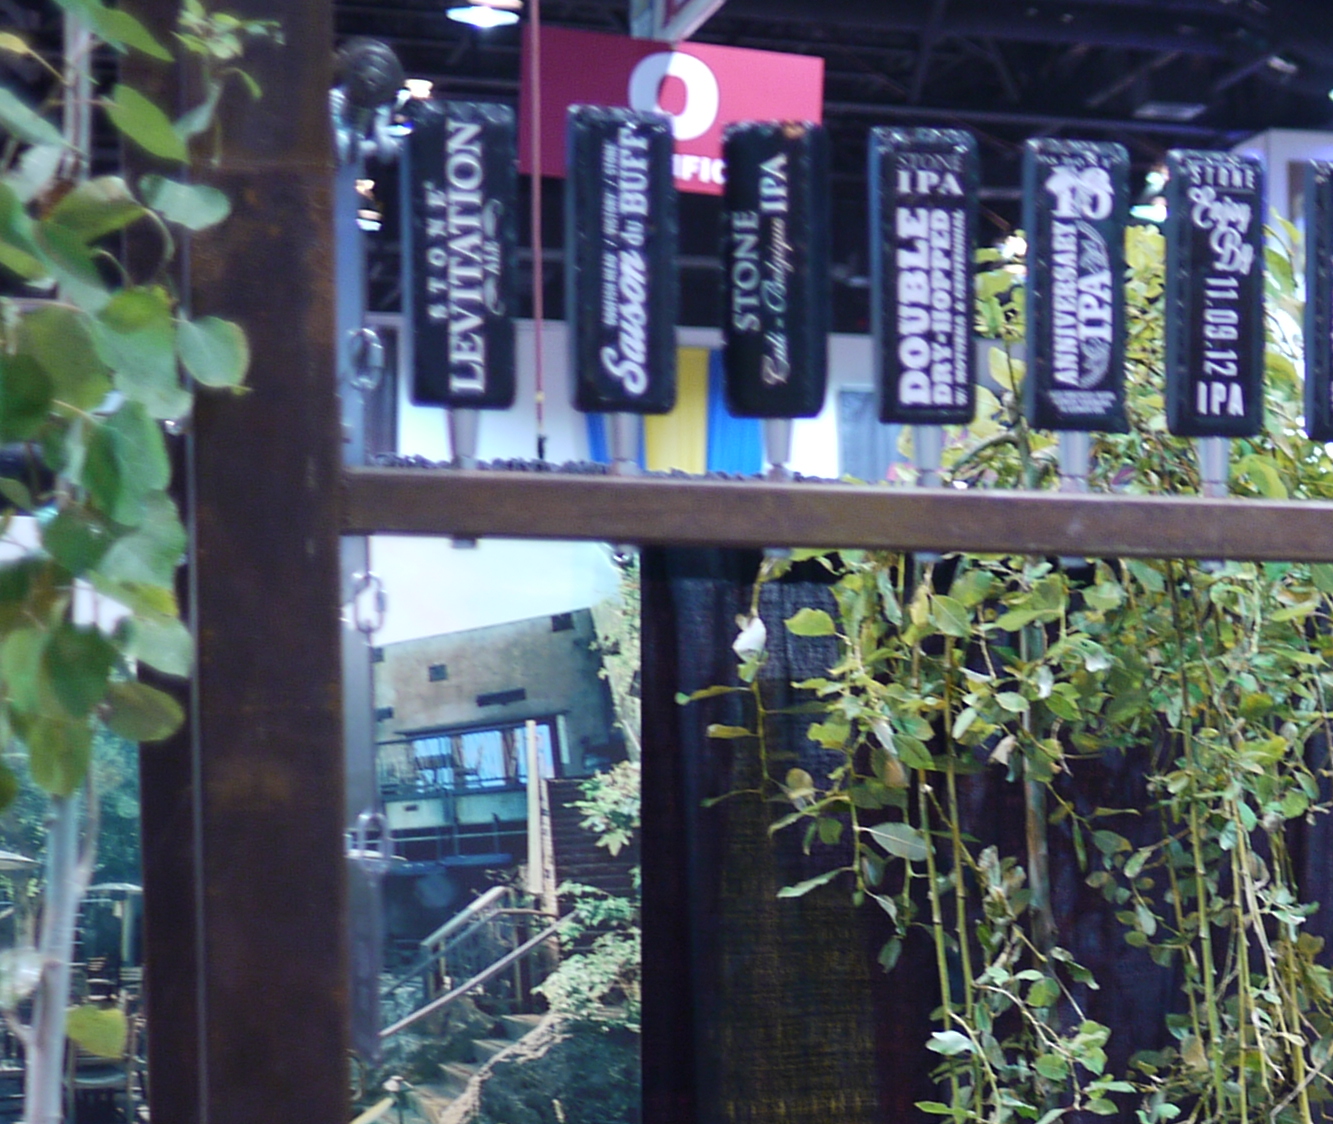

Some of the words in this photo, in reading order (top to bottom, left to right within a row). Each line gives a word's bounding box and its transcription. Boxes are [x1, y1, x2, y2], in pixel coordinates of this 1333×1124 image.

[628, 52, 719, 140] O
[618, 125, 649, 216] BUFF
[757, 151, 789, 213] IPA
[896, 170, 963, 195] IPA
[445, 116, 485, 393] LEVITATION
[620, 218, 646, 247] du
[730, 209, 762, 331] STONE
[600, 248, 647, 394] Saison
[896, 206, 931, 405] DOUBLE
[930, 207, 954, 405] DRY-HOPPED
[1052, 218, 1079, 386] ANNIVERSARY
[1077, 267, 1113, 343] IPA
[1203, 276, 1240, 376] 11.09.12
[1196, 379, 1245, 416] IPA
